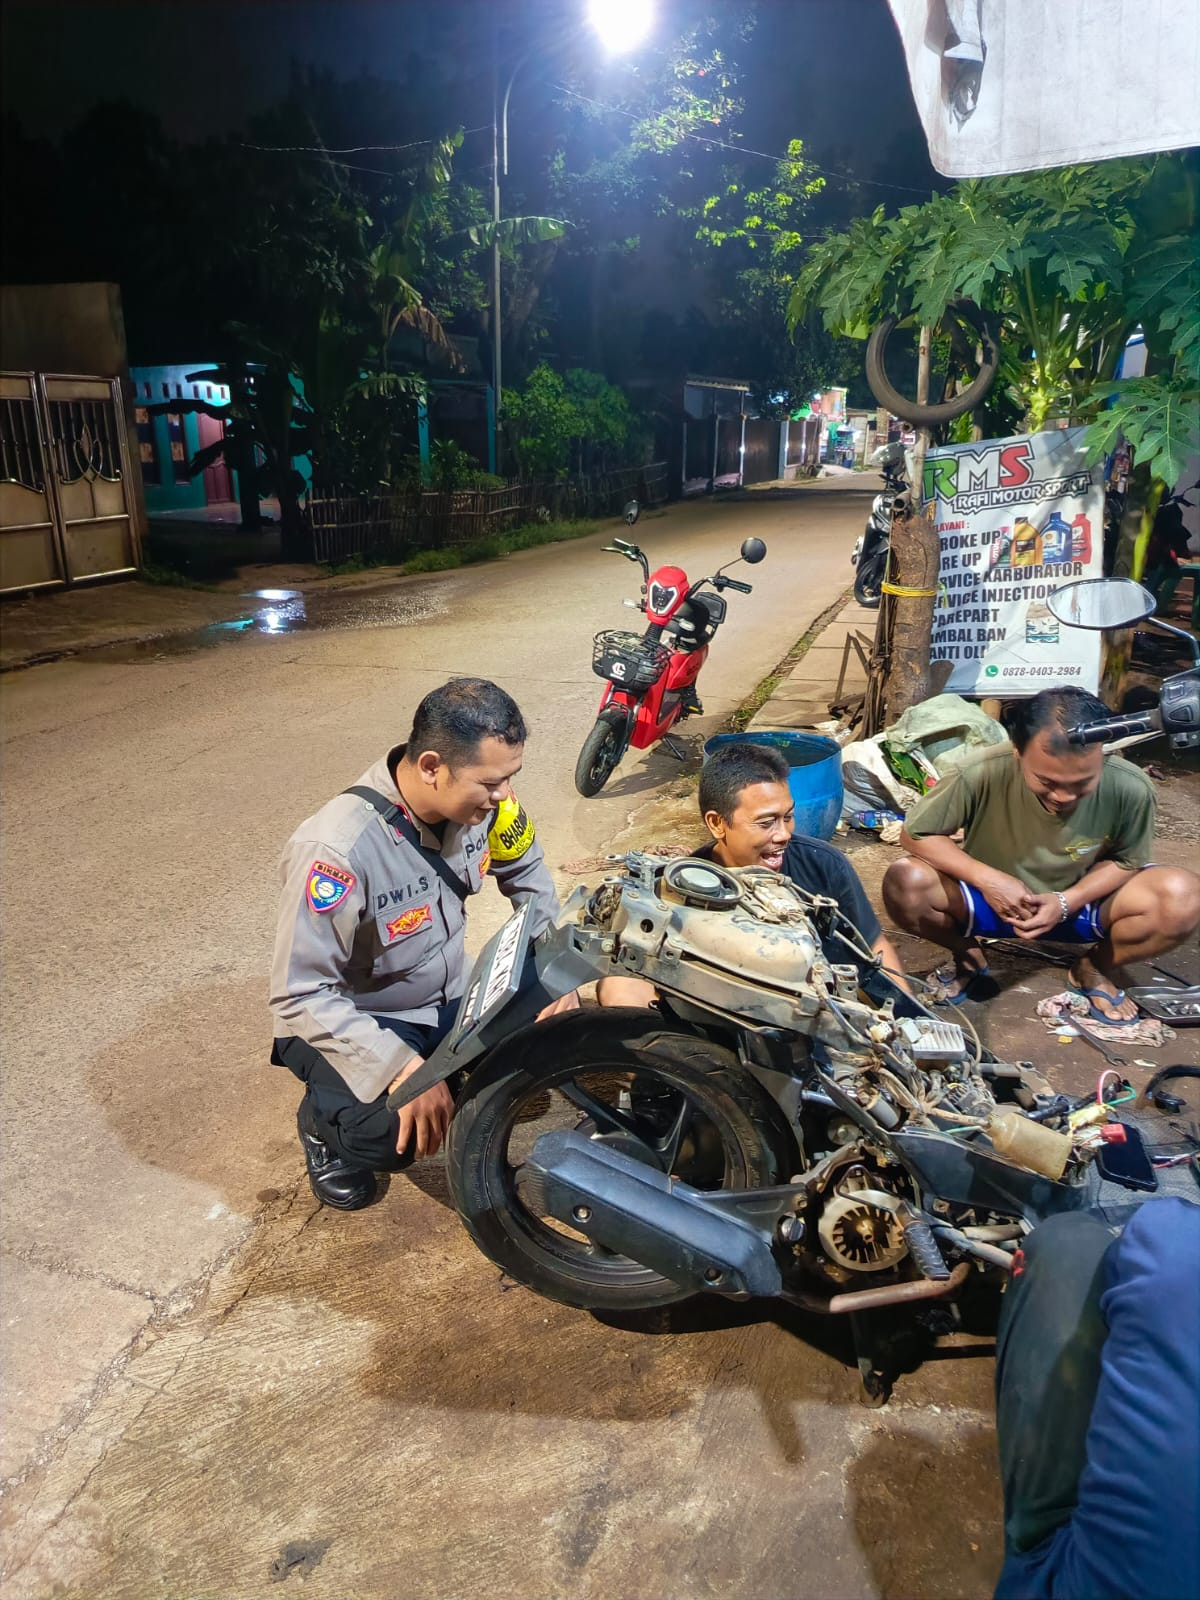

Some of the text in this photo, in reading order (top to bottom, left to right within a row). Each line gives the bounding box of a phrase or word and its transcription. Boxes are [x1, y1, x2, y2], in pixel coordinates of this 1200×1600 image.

[923, 444, 1031, 500] RMS
[957, 476, 1086, 509] RAFI MOTOR SPORT
[935, 520, 964, 532] LAYANI
[940, 533, 978, 551] ROKE
[981, 531, 1001, 546] UP
[942, 552, 981, 571] RE UP
[939, 562, 1083, 589] RVICE KARBURATOR
[932, 608, 1000, 628] PAREPART
[977, 627, 1006, 642] BAN
[930, 645, 986, 660] ANTI OLI
[1002, 666, 1082, 677] 0878-0403-2984
[465, 833, 488, 859] POL
